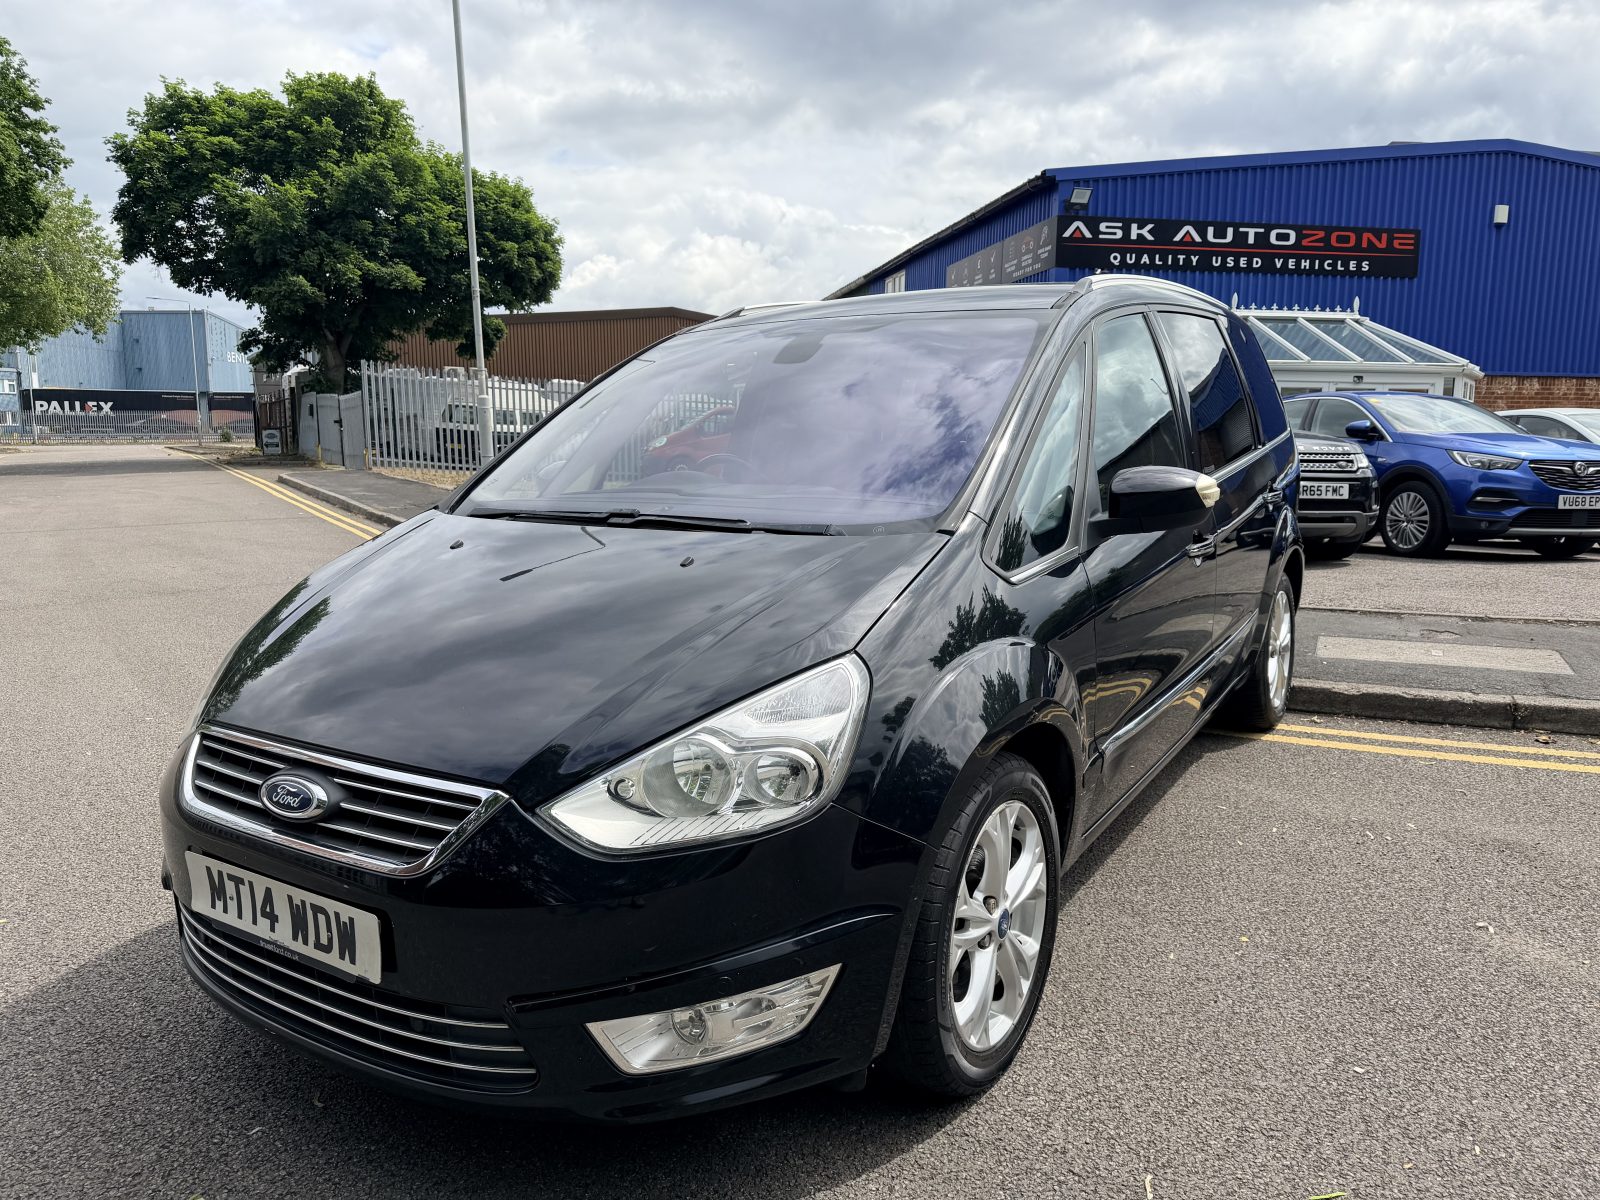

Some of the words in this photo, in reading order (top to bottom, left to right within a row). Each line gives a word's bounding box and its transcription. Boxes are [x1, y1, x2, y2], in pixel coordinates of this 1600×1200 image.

[1062, 220, 1155, 241] ASK
[1172, 225, 1416, 250] AUTOZONE
[1109, 252, 1200, 266] QUALITY
[1212, 255, 1262, 269] USED
[1274, 257, 1370, 272] VEHICLES
[34, 400, 115, 416] PALLEX
[1299, 484, 1323, 497] R65
[1325, 485, 1344, 497] FMC
[1562, 496, 1587, 507] VU68
[272, 784, 304, 808] Ford
[205, 865, 280, 934] MT14
[287, 893, 357, 966] WDW
